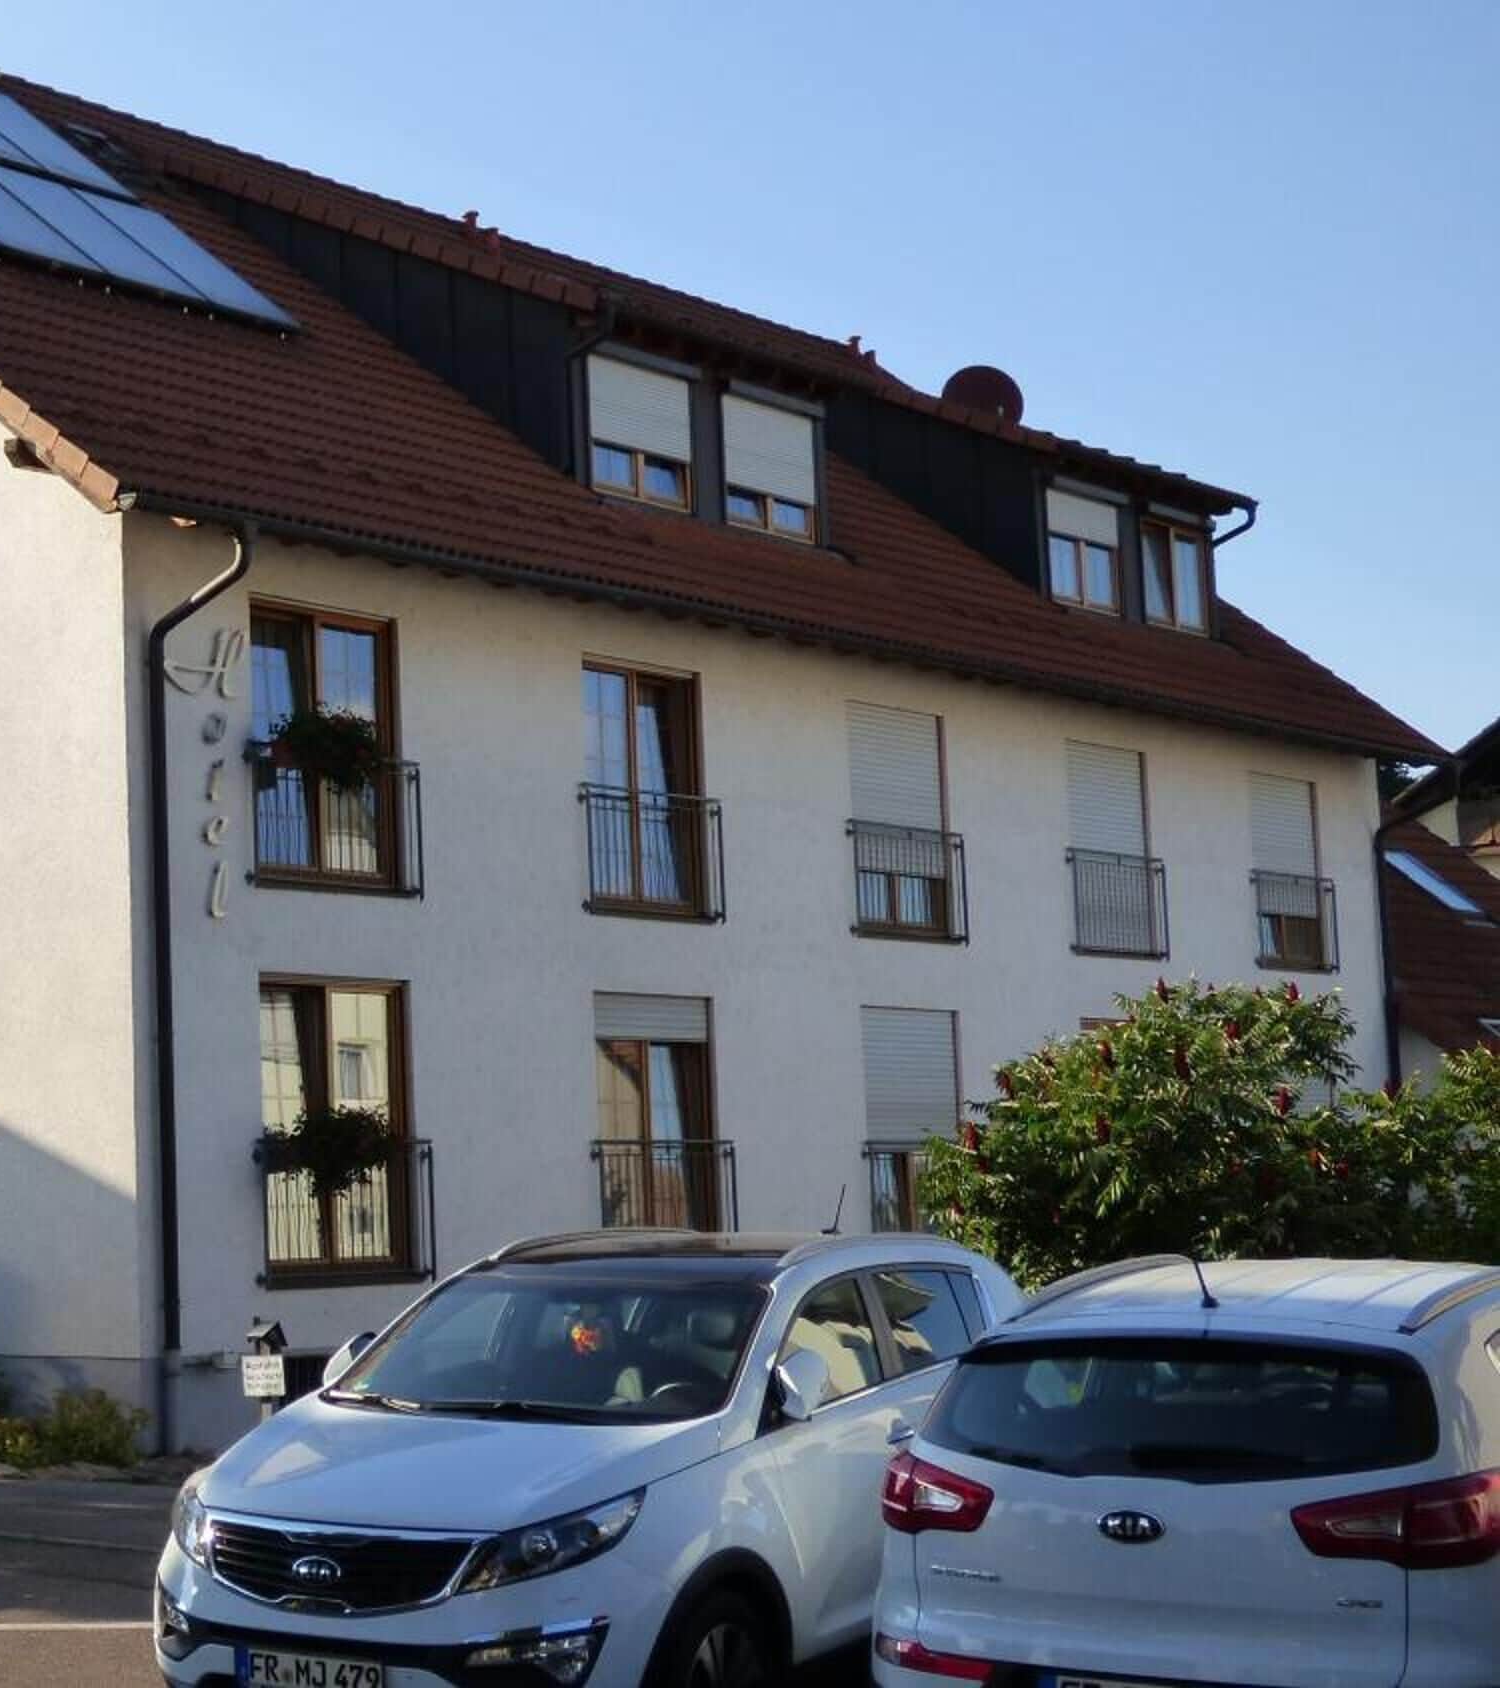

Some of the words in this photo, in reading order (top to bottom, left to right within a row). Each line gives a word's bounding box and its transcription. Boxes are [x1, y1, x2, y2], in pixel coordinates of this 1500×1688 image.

[163, 628, 246, 919] Hotel
[1107, 1515, 1155, 1536] KIA
[250, 1653, 278, 1681] FR
[295, 1659, 326, 1686] MJ
[334, 1663, 380, 1688] 479
